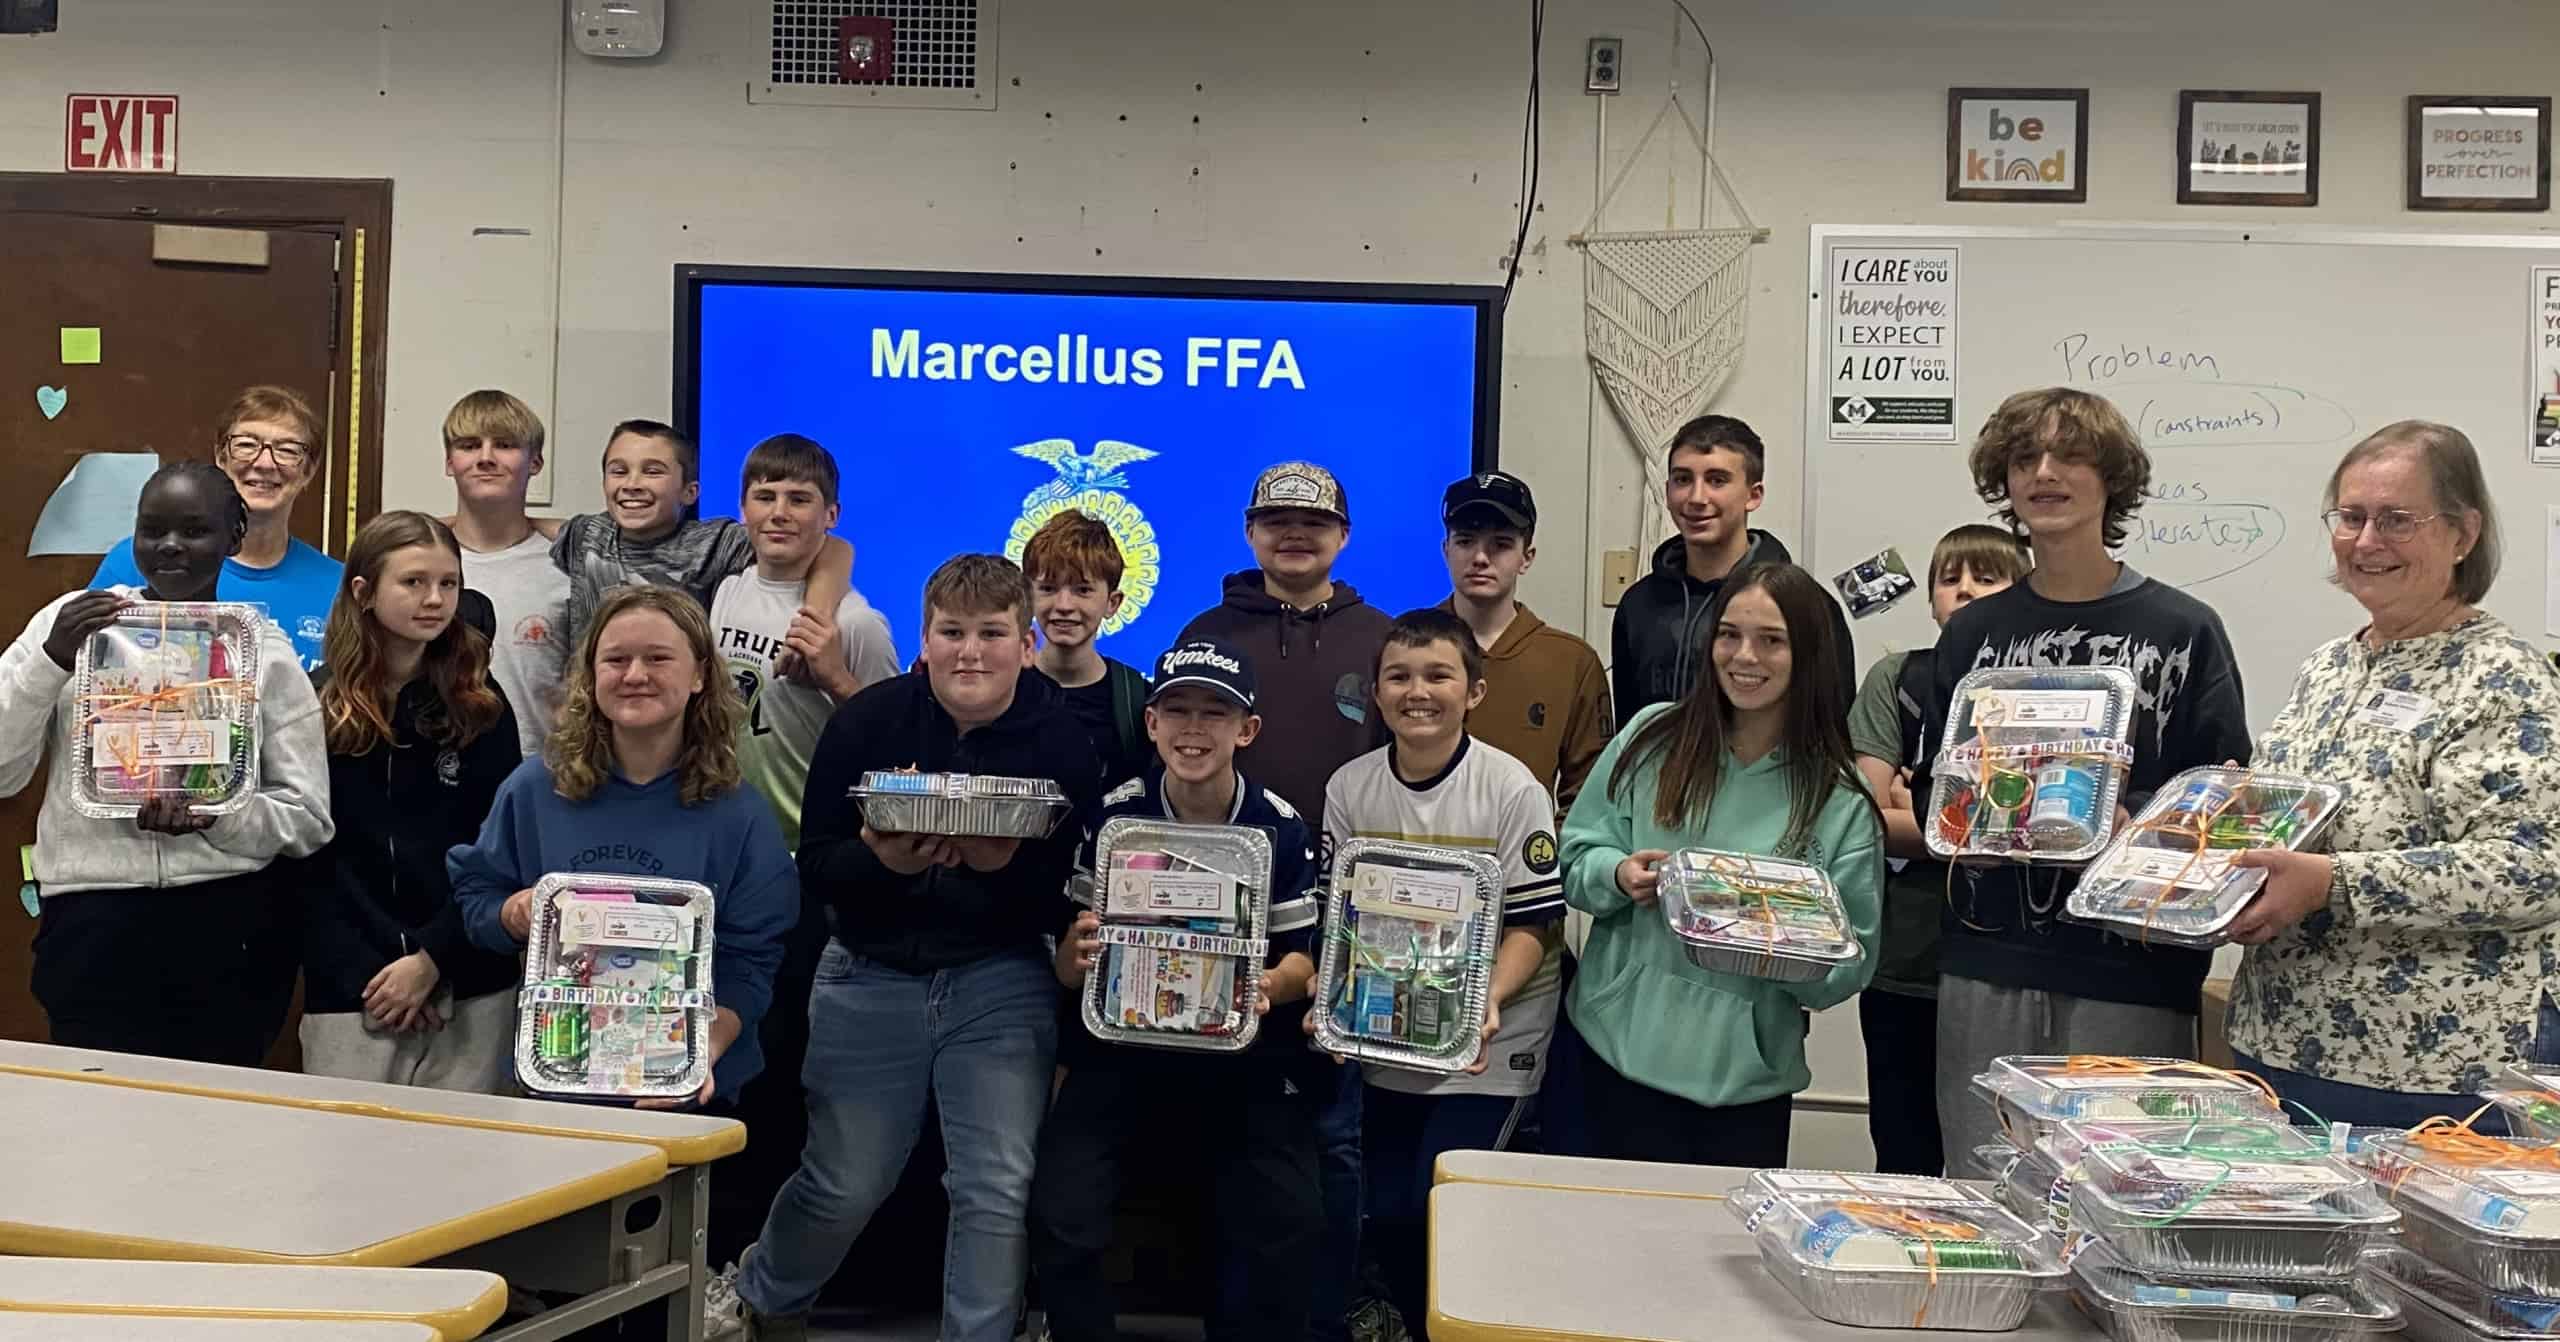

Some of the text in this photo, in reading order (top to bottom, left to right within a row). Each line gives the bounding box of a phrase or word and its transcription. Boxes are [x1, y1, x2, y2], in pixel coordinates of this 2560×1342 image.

[71, 99, 174, 169] EXIT
[1989, 108, 2044, 141] be
[2433, 129, 2523, 143] PROGRESS
[2425, 164, 2531, 179] PERFECTION
[1841, 259, 1911, 282] I CARE
[1913, 259, 1948, 269] about
[1913, 270, 1948, 282] YOU
[1852, 325, 1946, 345] EXPECT
[871, 327, 1306, 390] Marcellus FFA
[1838, 356, 1907, 381] A LOT
[1910, 355, 1946, 367] from
[2054, 333, 2220, 382] Problem
[719, 626, 785, 661] TRUE
[1162, 648, 1240, 675] Yankees
[2030, 739, 2101, 756] BIRTHDAY
[569, 843, 663, 874] FOREVER
[1127, 930, 1173, 948] HAPPY
[1189, 934, 1256, 956] BIRTHDAY
[552, 987, 623, 1004] BIRTHDAY
